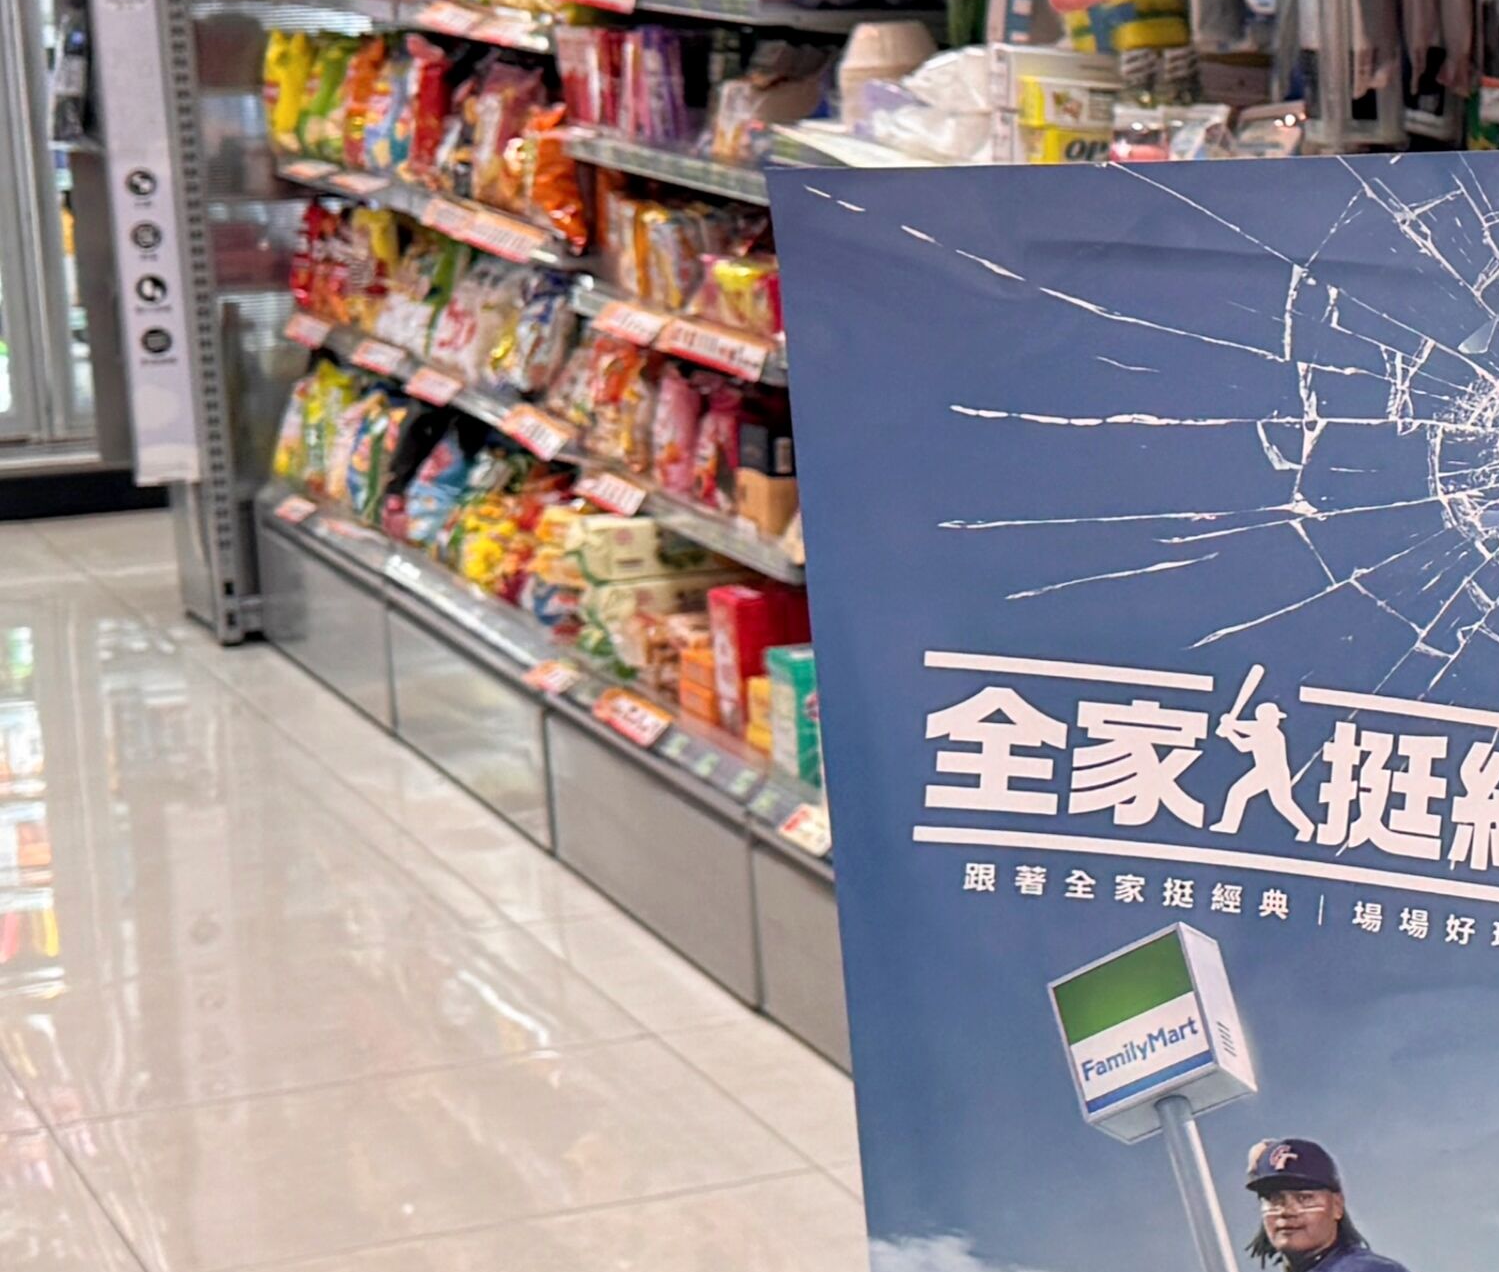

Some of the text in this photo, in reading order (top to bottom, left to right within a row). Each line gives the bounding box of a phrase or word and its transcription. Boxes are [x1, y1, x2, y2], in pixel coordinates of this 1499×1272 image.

[963, 861, 1292, 922] 跟著全家挺經典
[1081, 1016, 1199, 1082] FamilyMart
